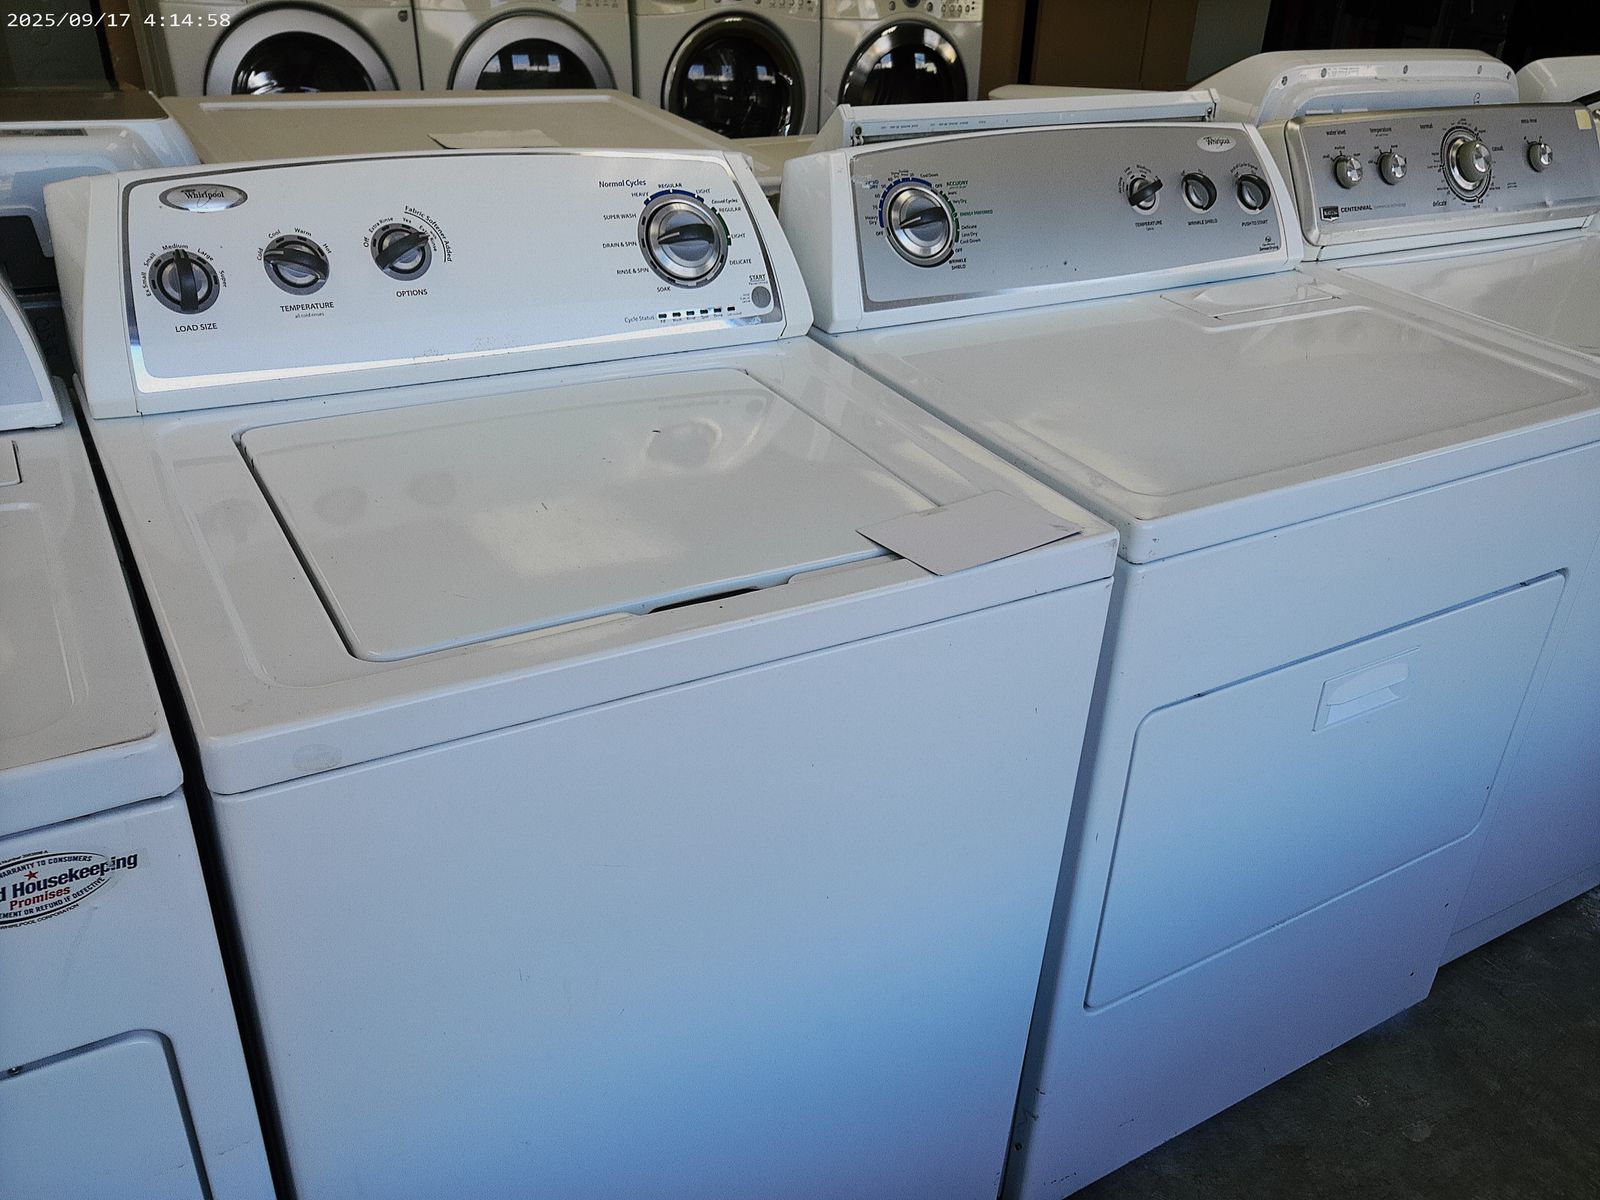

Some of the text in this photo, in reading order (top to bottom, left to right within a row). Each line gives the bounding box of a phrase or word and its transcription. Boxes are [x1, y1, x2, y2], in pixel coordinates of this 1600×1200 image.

[598, 179, 647, 189] Normal Cycles
[183, 190, 223, 203] Whirlpool
[1340, 204, 1373, 213] CENTENNIAL
[268, 228, 282, 240] Cool
[294, 226, 312, 237] Warm
[405, 205, 453, 262] Fabric Softener Added
[322, 242, 333, 254] Hot
[144, 252, 156, 267] Small
[197, 248, 214, 262] Large
[256, 248, 264, 261] Cold
[729, 258, 752, 266] DELICATE
[219, 270, 228, 288] Super
[396, 288, 428, 298] OPTIONS
[280, 301, 335, 313] TEMPERATURE
[624, 316, 640, 324] Cycle
[639, 314, 654, 322] Status
[174, 322, 218, 334] LOAD SIZE
[36, 859, 46, 867] TO
[48, 855, 92, 865] CONSUMERS
[12, 852, 138, 899] Housekeeping
[10, 886, 71, 911] Promises
[24, 908, 34, 916] OR
[35, 899, 64, 914] REFUND
[72, 876, 106, 900] DEFECTIVE
